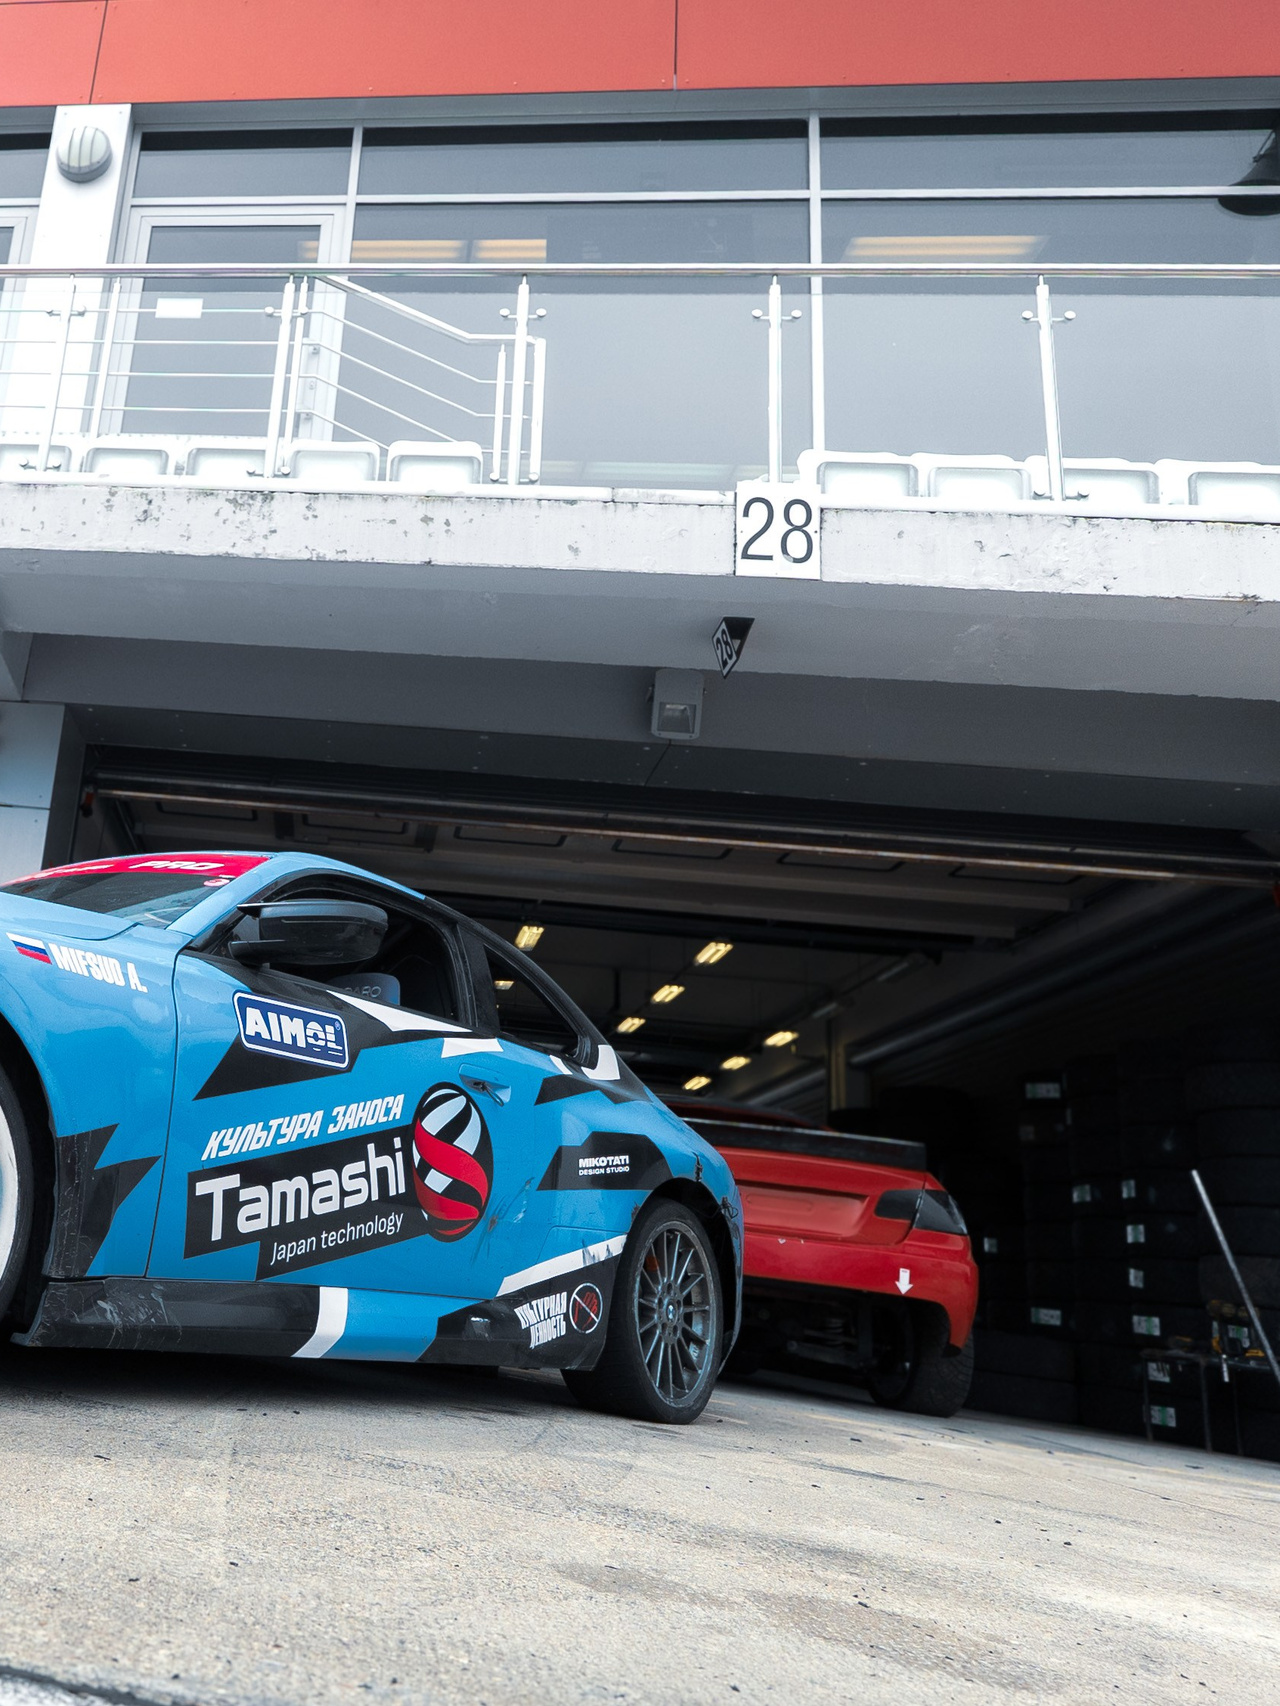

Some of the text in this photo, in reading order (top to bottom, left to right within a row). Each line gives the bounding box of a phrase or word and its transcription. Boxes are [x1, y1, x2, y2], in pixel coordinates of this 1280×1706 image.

[741, 496, 814, 564] 28
[716, 628, 735, 670] 28
[48, 942, 149, 993] MIFSUD A.
[245, 1006, 344, 1054] AIMOL
[201, 1094, 405, 1161] КУЛЬТУРА ЗАНОСА
[579, 1155, 629, 1168] MIKOTATI
[579, 1166, 630, 1176] DESIGN STUDIO
[195, 1136, 406, 1242] Tamashi
[270, 1212, 404, 1266] Japan technology
